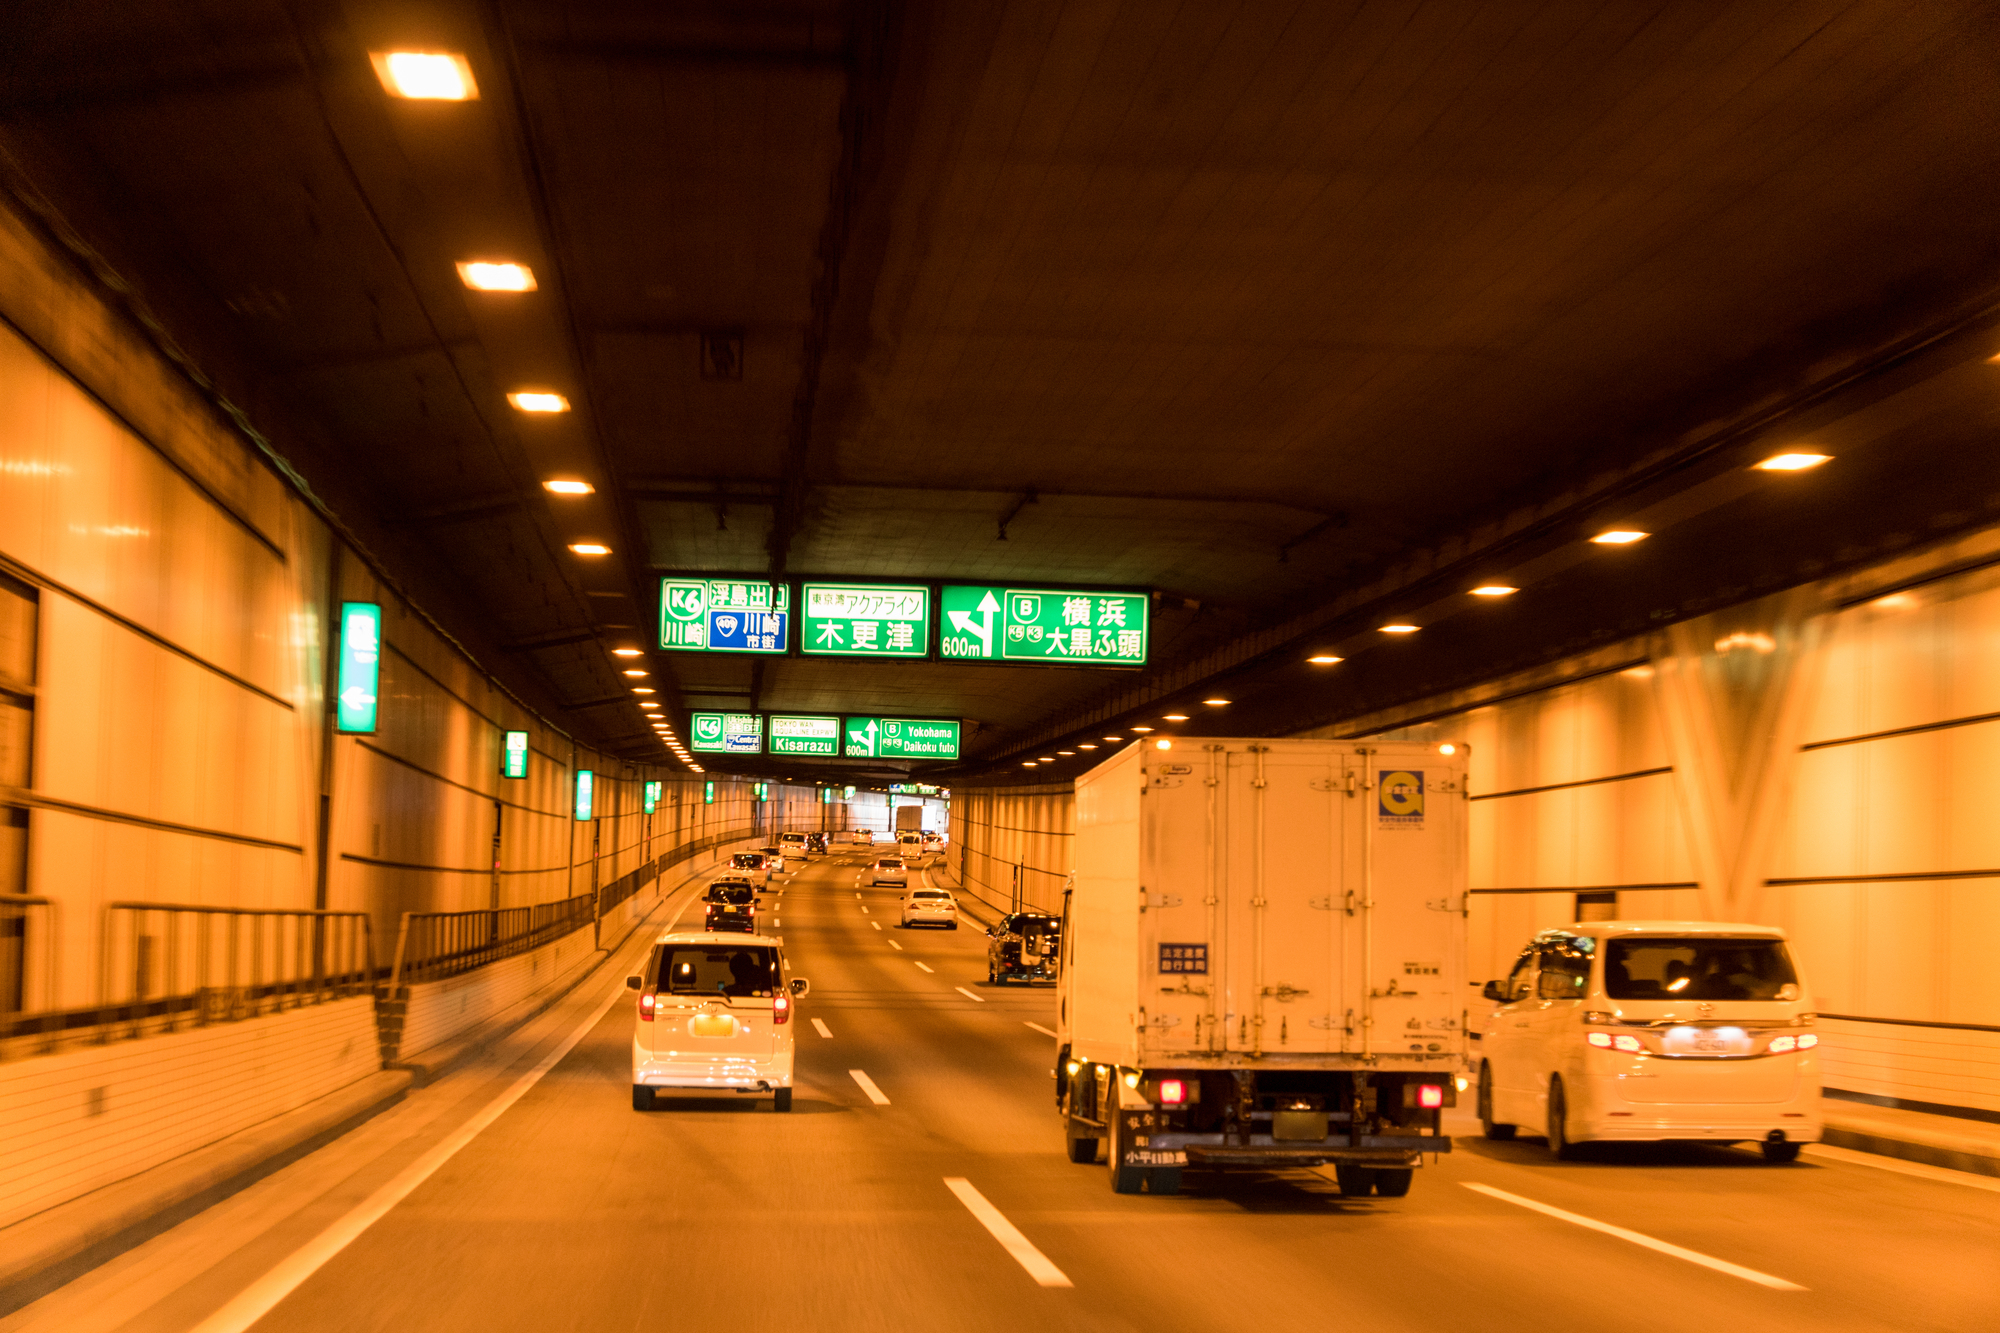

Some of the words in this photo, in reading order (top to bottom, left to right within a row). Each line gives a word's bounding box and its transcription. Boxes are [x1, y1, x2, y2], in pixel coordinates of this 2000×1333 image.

[672, 589, 701, 613] K6
[711, 583, 786, 607] 浮島出口
[812, 593, 920, 616] 東京湾アクアライン
[1020, 599, 1033, 616] B
[1062, 596, 1127, 627] 横浜
[719, 618, 734, 629] 409
[743, 612, 780, 636] 川崎
[664, 620, 704, 646] 川崎
[816, 618, 914, 651] 木更津
[1009, 626, 1023, 639] K5
[1028, 627, 1041, 639] K3
[746, 634, 775, 649] 市街
[942, 636, 980, 657] 600m
[1045, 626, 1142, 658] 大黒ふ頭
[700, 720, 718, 735] K6
[727, 716, 760, 724] Ukishia
[889, 724, 897, 734] B
[908, 726, 952, 738] Yokohama
[694, 740, 723, 748] Kawasaki
[735, 735, 759, 743] Central
[775, 738, 832, 752] Kisarazu
[846, 745, 868, 756] 600m
[904, 741, 937, 753] Daikoku
[939, 742, 955, 753] futo
